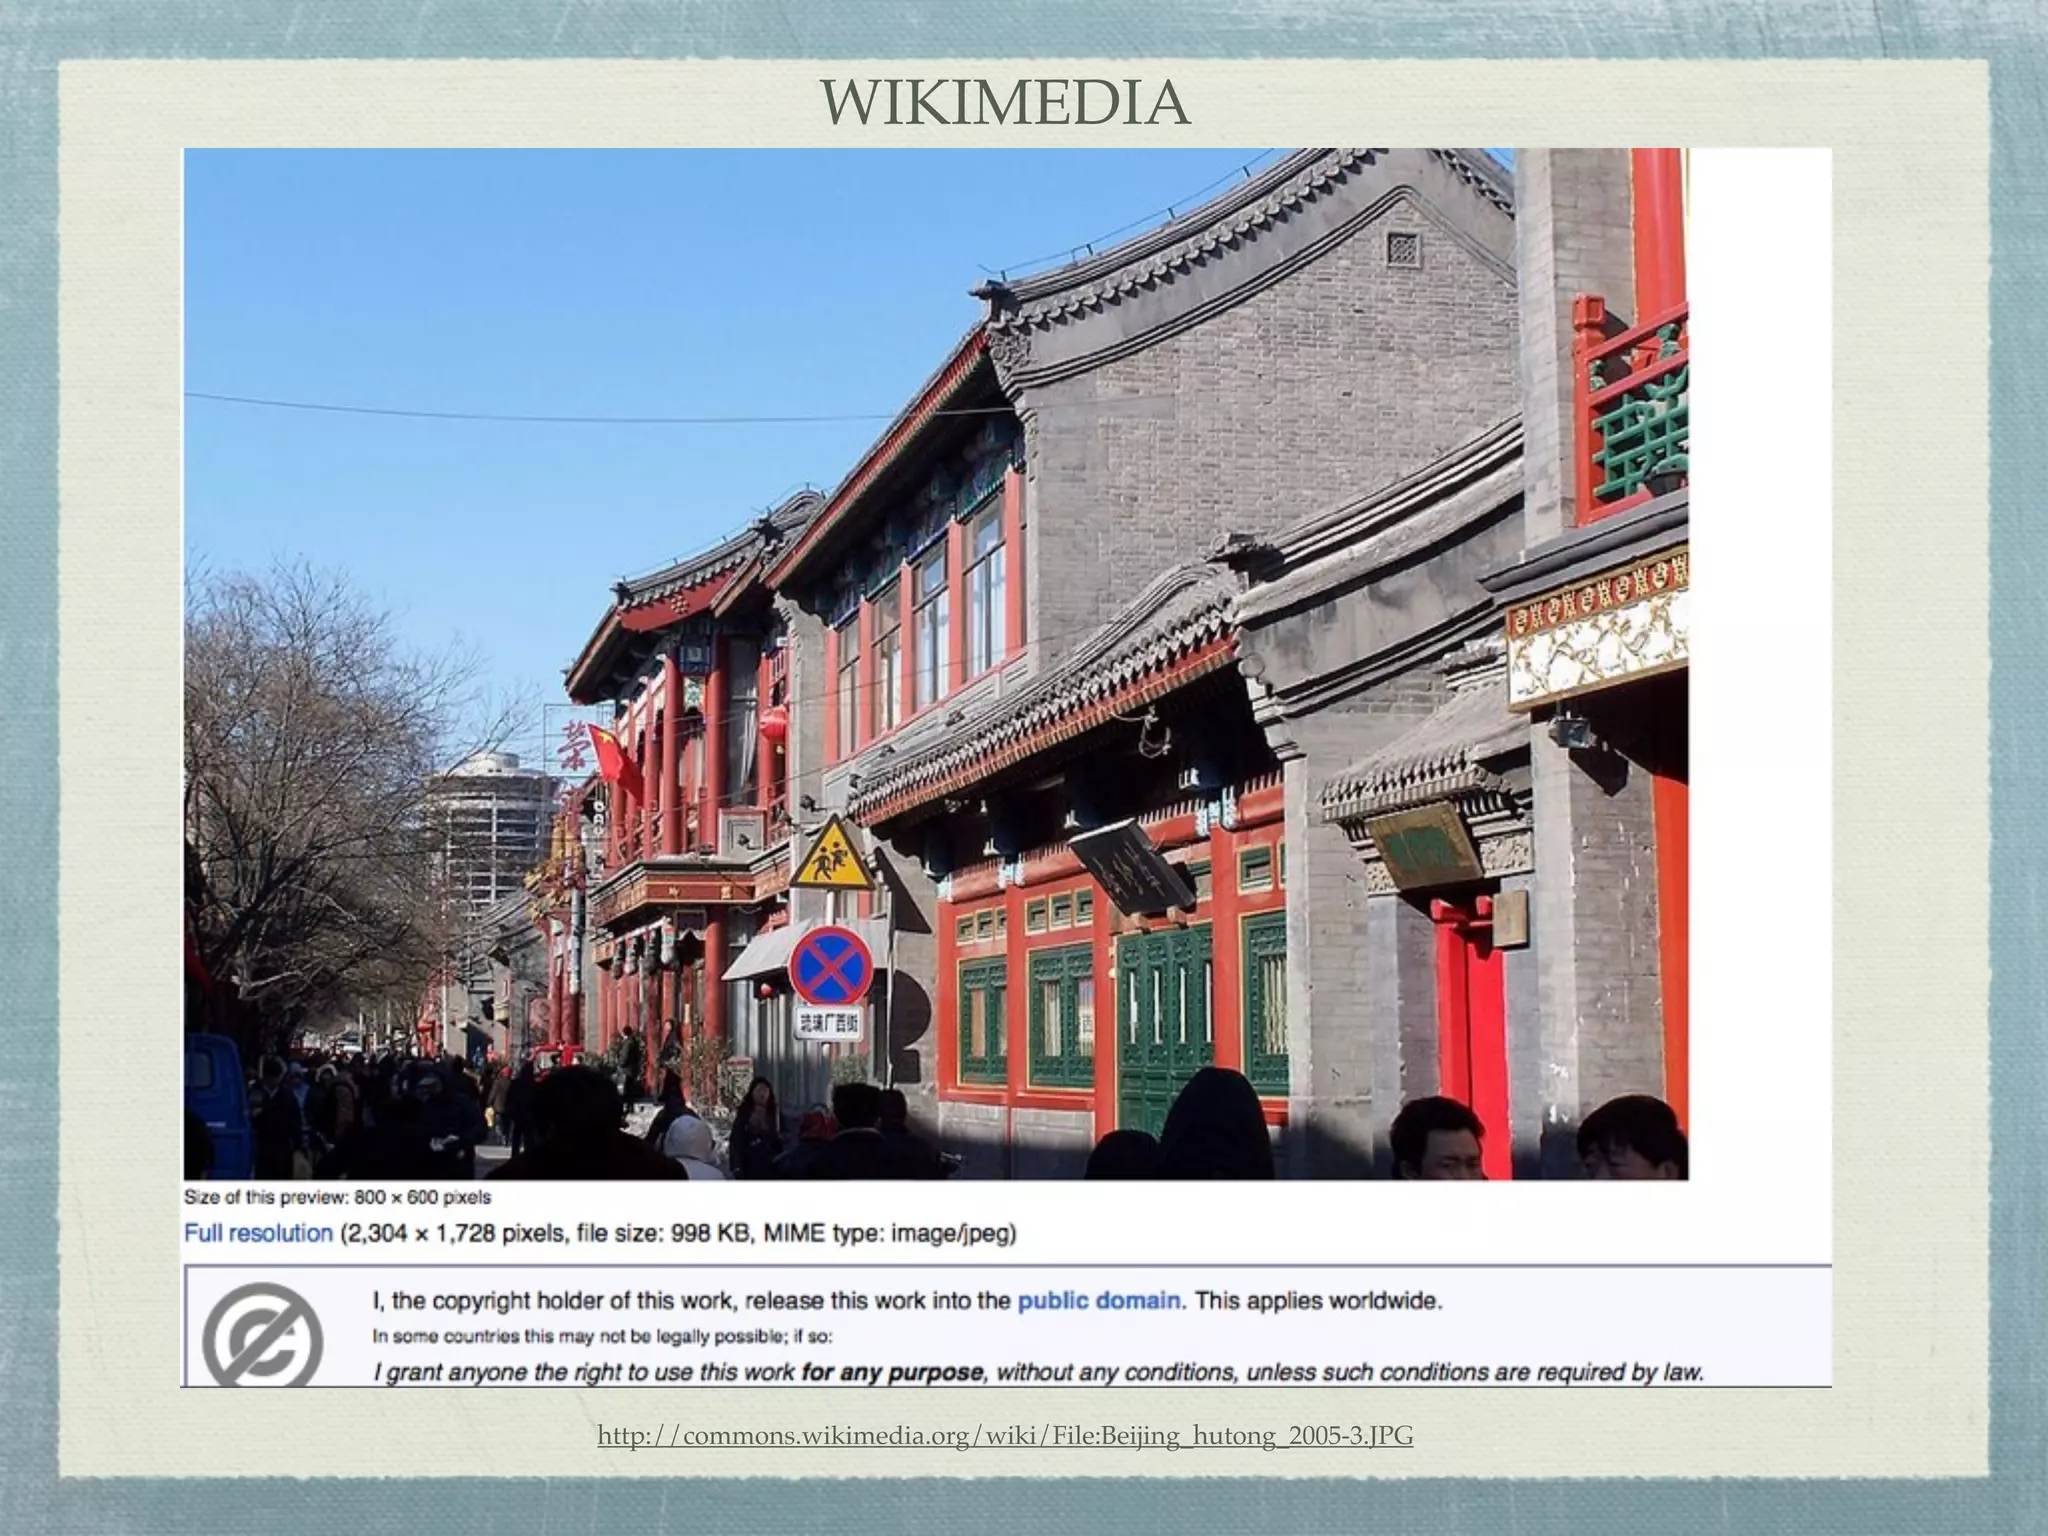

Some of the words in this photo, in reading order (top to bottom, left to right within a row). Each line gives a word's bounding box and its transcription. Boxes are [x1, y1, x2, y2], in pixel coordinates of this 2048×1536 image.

[183, 1187, 221, 1206] Size
[223, 1188, 242, 1205] of
[245, 1189, 276, 1206] this
[279, 1189, 350, 1209] preview:
[353, 1188, 387, 1206] 800
[406, 1188, 439, 1206] 600
[442, 1188, 493, 1209] pixels
[184, 1221, 224, 1244] Full
[228, 1222, 334, 1244] resolution
[340, 1221, 409, 1247] (2,304
[436, 1222, 497, 1246] 1,728
[502, 1222, 571, 1248] pixels,
[576, 1221, 609, 1244] file
[614, 1222, 665, 1244] size:
[670, 1222, 713, 1244] 998
[716, 1221, 756, 1245] KB,
[763, 1221, 826, 1244] MIME
[831, 1223, 885, 1248] type:
[891, 1221, 1018, 1249] image/jpeg)
[373, 1289, 385, 1313] I,
[390, 1289, 427, 1311] the
[432, 1289, 532, 1316] copyright
[536, 1289, 606, 1311] holder
[609, 1289, 632, 1311] of
[635, 1289, 676, 1311] this
[680, 1289, 739, 1314] work,
[744, 1289, 826, 1311] release
[829, 1289, 869, 1311] this
[874, 1289, 927, 1311] work
[932, 1289, 973, 1311] into
[976, 1289, 1012, 1311] the
[1018, 1289, 1090, 1316] public
[1095, 1289, 1188, 1311] domain.
[1193, 1289, 1242, 1311] This
[1245, 1289, 1324, 1315] applies
[1327, 1289, 1444, 1311] worldwide.
[372, 1327, 389, 1345] In
[392, 1330, 440, 1345] some
[442, 1327, 521, 1345] countries
[524, 1327, 555, 1345] this
[558, 1330, 596, 1348] may
[599, 1328, 627, 1345] not
[630, 1327, 652, 1345] be
[656, 1327, 711, 1349] legally
[714, 1327, 789, 1348] possible;
[793, 1327, 804, 1345] if
[807, 1330, 833, 1345] so:
[373, 1361, 383, 1382] I
[385, 1362, 445, 1385] grant
[447, 1365, 529, 1385] anyone
[534, 1361, 569, 1383] the
[573, 1361, 624, 1385] right
[627, 1362, 650, 1383] to
[654, 1365, 695, 1383] use
[700, 1361, 739, 1382] this
[744, 1361, 797, 1383] work
[801, 1360, 837, 1382] for
[839, 1365, 884, 1385] any
[886, 1365, 989, 1385] purpose,
[996, 1361, 1075, 1382] without
[1078, 1365, 1121, 1385] any
[1124, 1361, 1239, 1385] conditions,
[1246, 1361, 1318, 1383] unless
[1321, 1361, 1375, 1383] such
[1379, 1361, 1491, 1383] conditions
[1493, 1365, 1532, 1382] are
[1536, 1361, 1628, 1385] required
[1631, 1361, 1660, 1385] by
[1663, 1361, 1704, 1383] law.
